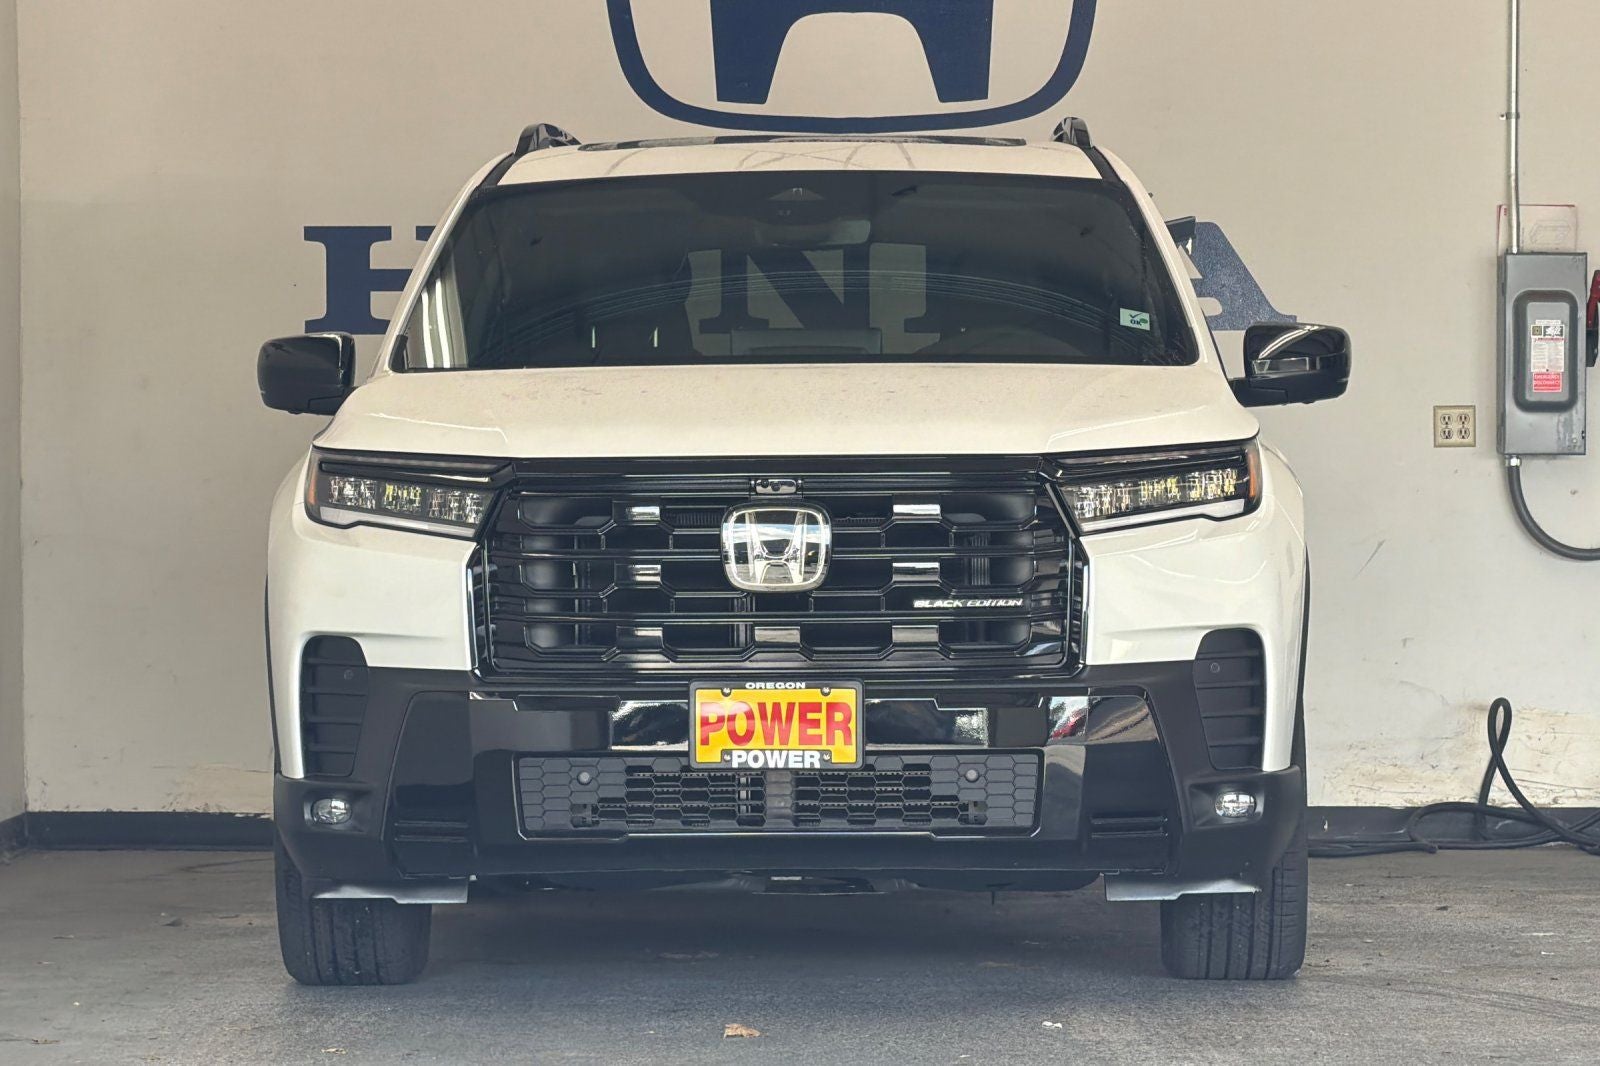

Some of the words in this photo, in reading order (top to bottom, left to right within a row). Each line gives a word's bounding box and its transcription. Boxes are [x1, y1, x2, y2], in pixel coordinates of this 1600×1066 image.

[914, 599, 962, 608] BLACK
[966, 598, 1023, 608] EDITION
[745, 681, 806, 690] OREGON
[700, 701, 853, 746] POWER
[731, 750, 821, 769] POWER
